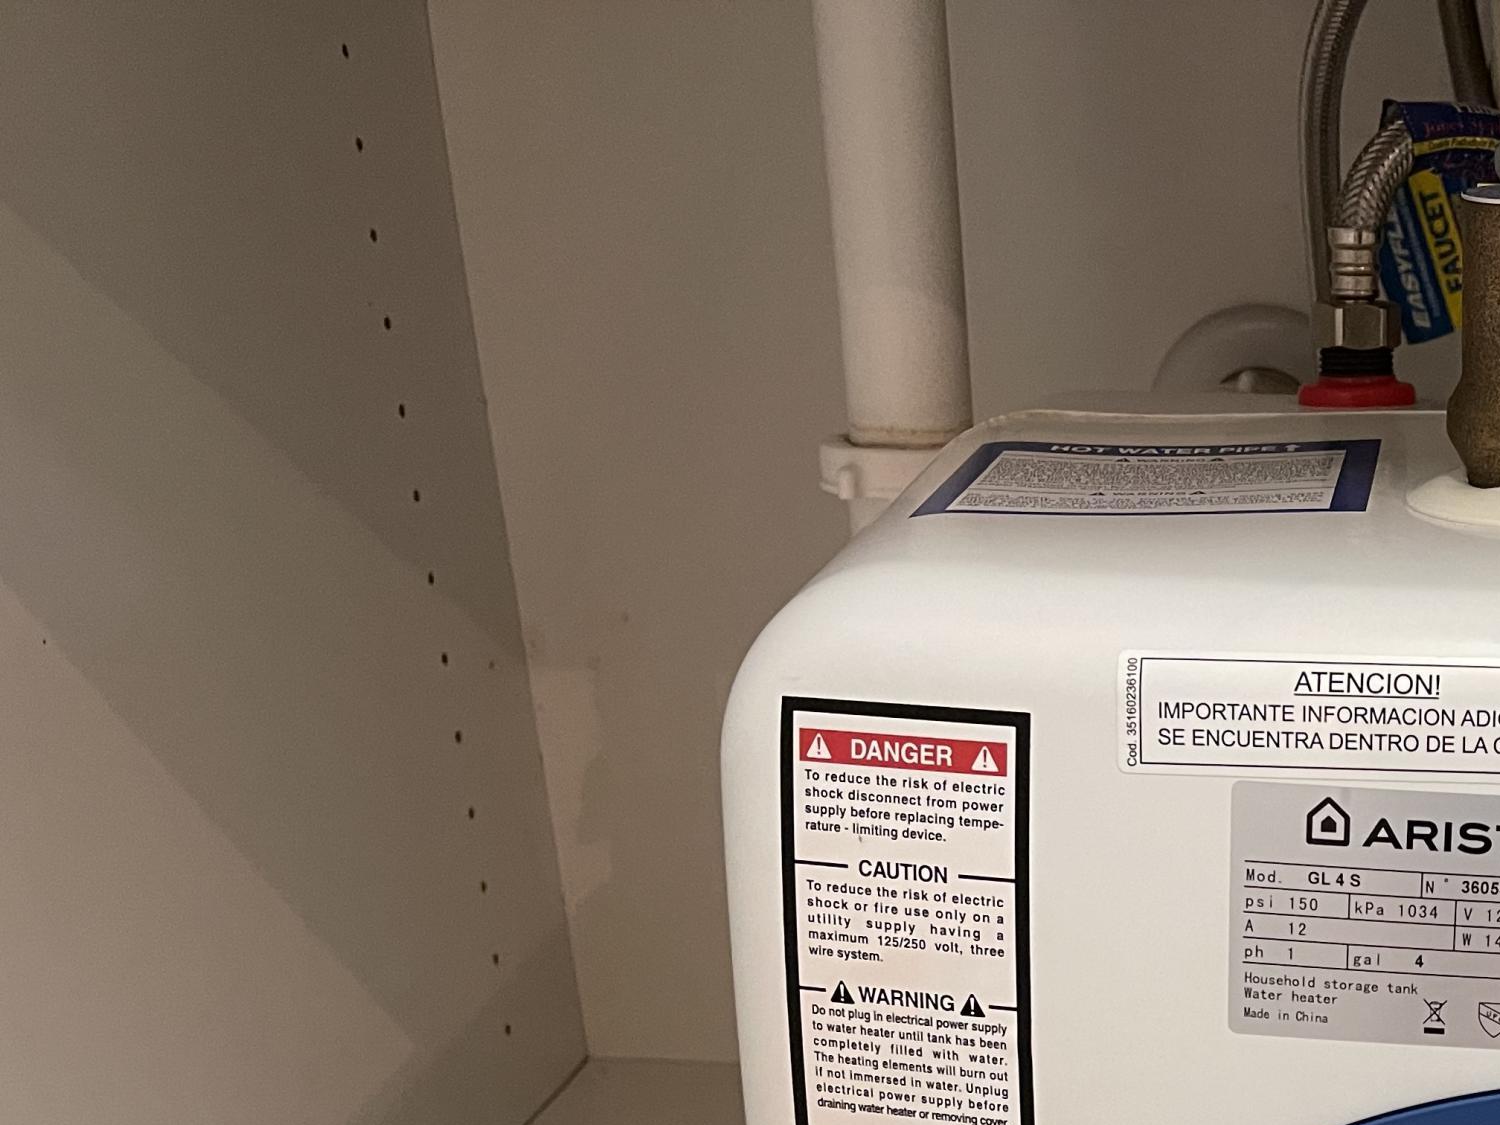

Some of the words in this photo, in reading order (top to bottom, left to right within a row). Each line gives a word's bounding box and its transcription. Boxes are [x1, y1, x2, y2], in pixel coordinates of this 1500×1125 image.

[1419, 191, 1462, 294] FAUCET
[1050, 445, 1105, 453] HOT
[1119, 446, 1211, 455] WATER
[1219, 445, 1277, 454] PIPE
[1126, 658, 1137, 735] 35160236100
[1294, 672, 1440, 699] ATENCION!
[1159, 702, 1294, 722] IMPORTANTE
[1303, 706, 1455, 726] INFORMACION
[1158, 728, 1185, 745] SE
[1193, 729, 1324, 749] ENCUENTRA
[1330, 733, 1419, 752] DENTRO
[1427, 736, 1455, 753] DE
[1463, 736, 1488, 753] LA
[852, 739, 952, 766] DANGER
[1127, 740, 1137, 766] Cod.
[805, 769, 819, 780] To
[825, 772, 870, 784] reduce
[876, 775, 896, 787] the
[903, 777, 928, 789] risk
[934, 780, 946, 791] of
[953, 782, 1005, 795] electric
[805, 787, 843, 799] shock
[848, 790, 921, 806] disconnect
[927, 796, 956, 808] from
[963, 802, 1003, 812] power
[805, 805, 846, 819] supply
[851, 806, 890, 820] before
[895, 812, 954, 828] replacing
[959, 816, 1004, 831] tempe-
[806, 821, 840, 832] rature
[853, 823, 898, 841] limiting
[902, 828, 946, 841] device.
[859, 860, 947, 883] CAUTION
[1246, 868, 1281, 883] Mod.
[1246, 896, 1272, 909] psi
[1290, 898, 1317, 911] 150
[1355, 901, 1383, 915] kPa
[1400, 905, 1437, 918] 1034
[1464, 908, 1472, 920] V
[1245, 919, 1253, 932] A
[1290, 923, 1306, 935] 12
[1463, 933, 1471, 946] W
[1245, 945, 1263, 958] ph
[1289, 948, 1292, 960] 1
[1354, 954, 1379, 967] gal
[1415, 955, 1424, 967] 4
[1245, 972, 1315, 988] Household
[1324, 980, 1378, 993] storage
[1388, 984, 1417, 994] tank
[858, 986, 954, 1011] WARNING
[1244, 987, 1282, 1000] Water
[1292, 991, 1337, 1004] heater
[1244, 1007, 1269, 1019] Made
[1278, 1009, 1289, 1021] in
[1296, 1011, 1328, 1023] China
